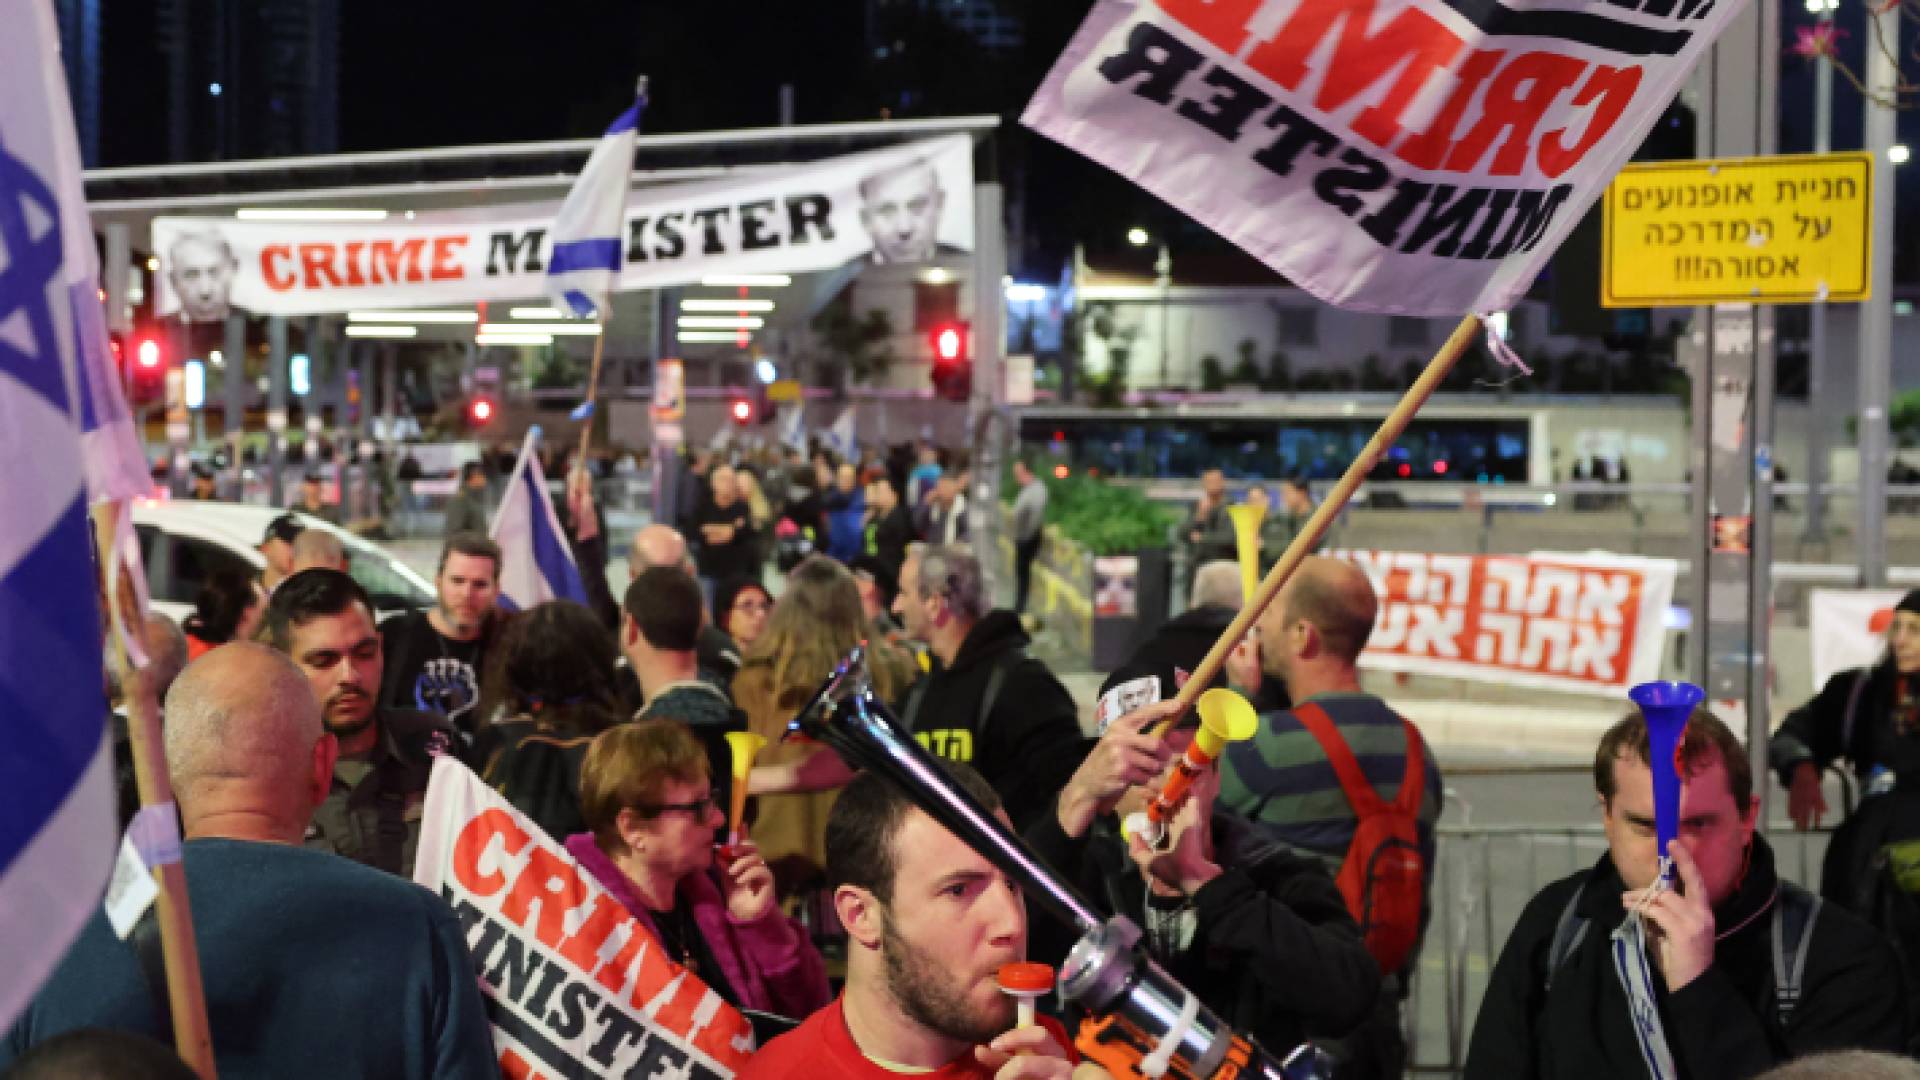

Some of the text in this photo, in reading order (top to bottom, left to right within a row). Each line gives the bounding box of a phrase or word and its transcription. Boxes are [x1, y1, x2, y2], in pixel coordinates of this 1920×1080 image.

[1622, 175, 1857, 211] חניית אופנועים
[258, 193, 836, 292] CRIME MISTER
[1643, 211, 1832, 246] על המדרכה
[1674, 255, 1800, 281] אסורה!!!
[1483, 559, 1630, 626] אתה
[1366, 602, 1624, 680] אתה אש
